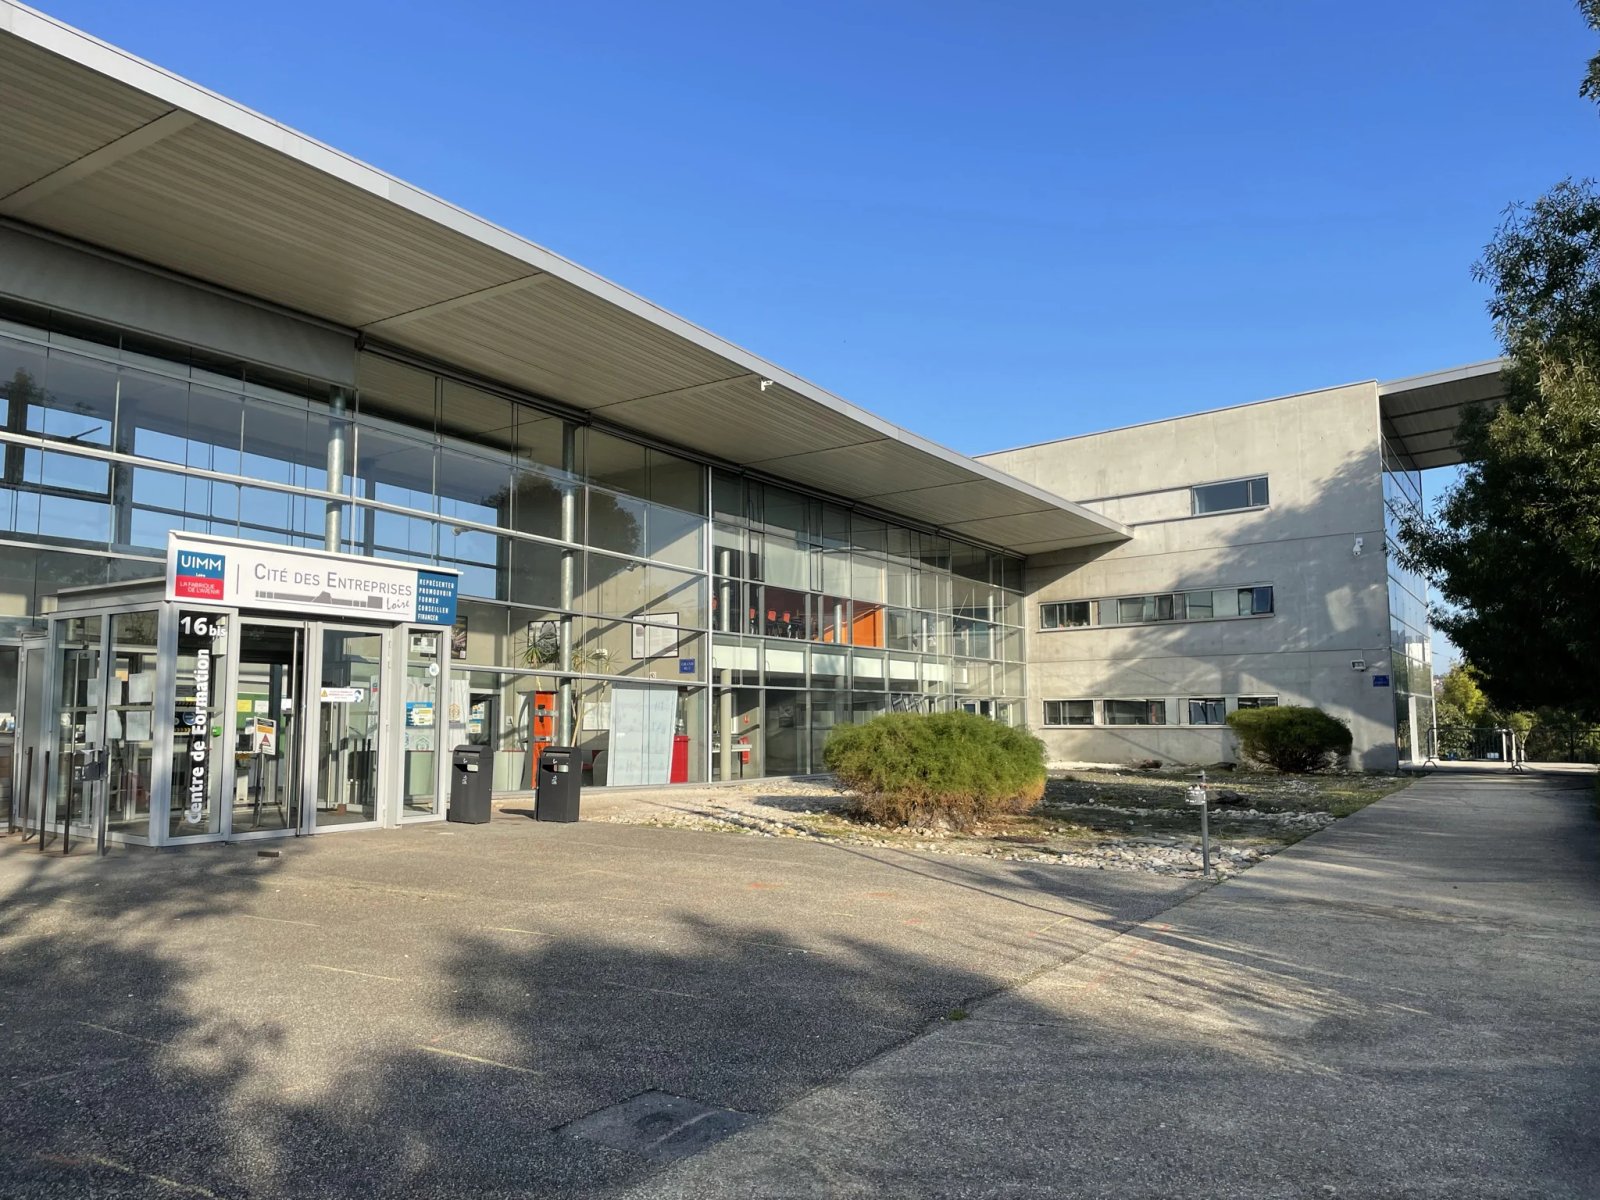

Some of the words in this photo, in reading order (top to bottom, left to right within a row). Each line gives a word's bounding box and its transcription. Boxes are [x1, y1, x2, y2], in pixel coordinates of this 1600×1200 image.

[181, 554, 222, 571] UIMM
[254, 563, 288, 582] CITÉ
[294, 571, 320, 586] DES
[327, 571, 412, 597] ENTREPRISES
[386, 597, 410, 611] Loire
[418, 596, 439, 604] FORMER
[418, 604, 449, 614] CONSEILLER
[180, 616, 208, 636] 16
[208, 624, 227, 637] bis
[417, 613, 439, 621] FINANCER
[191, 648, 210, 735] Formation
[190, 740, 206, 763] de
[186, 766, 205, 824] Centre
